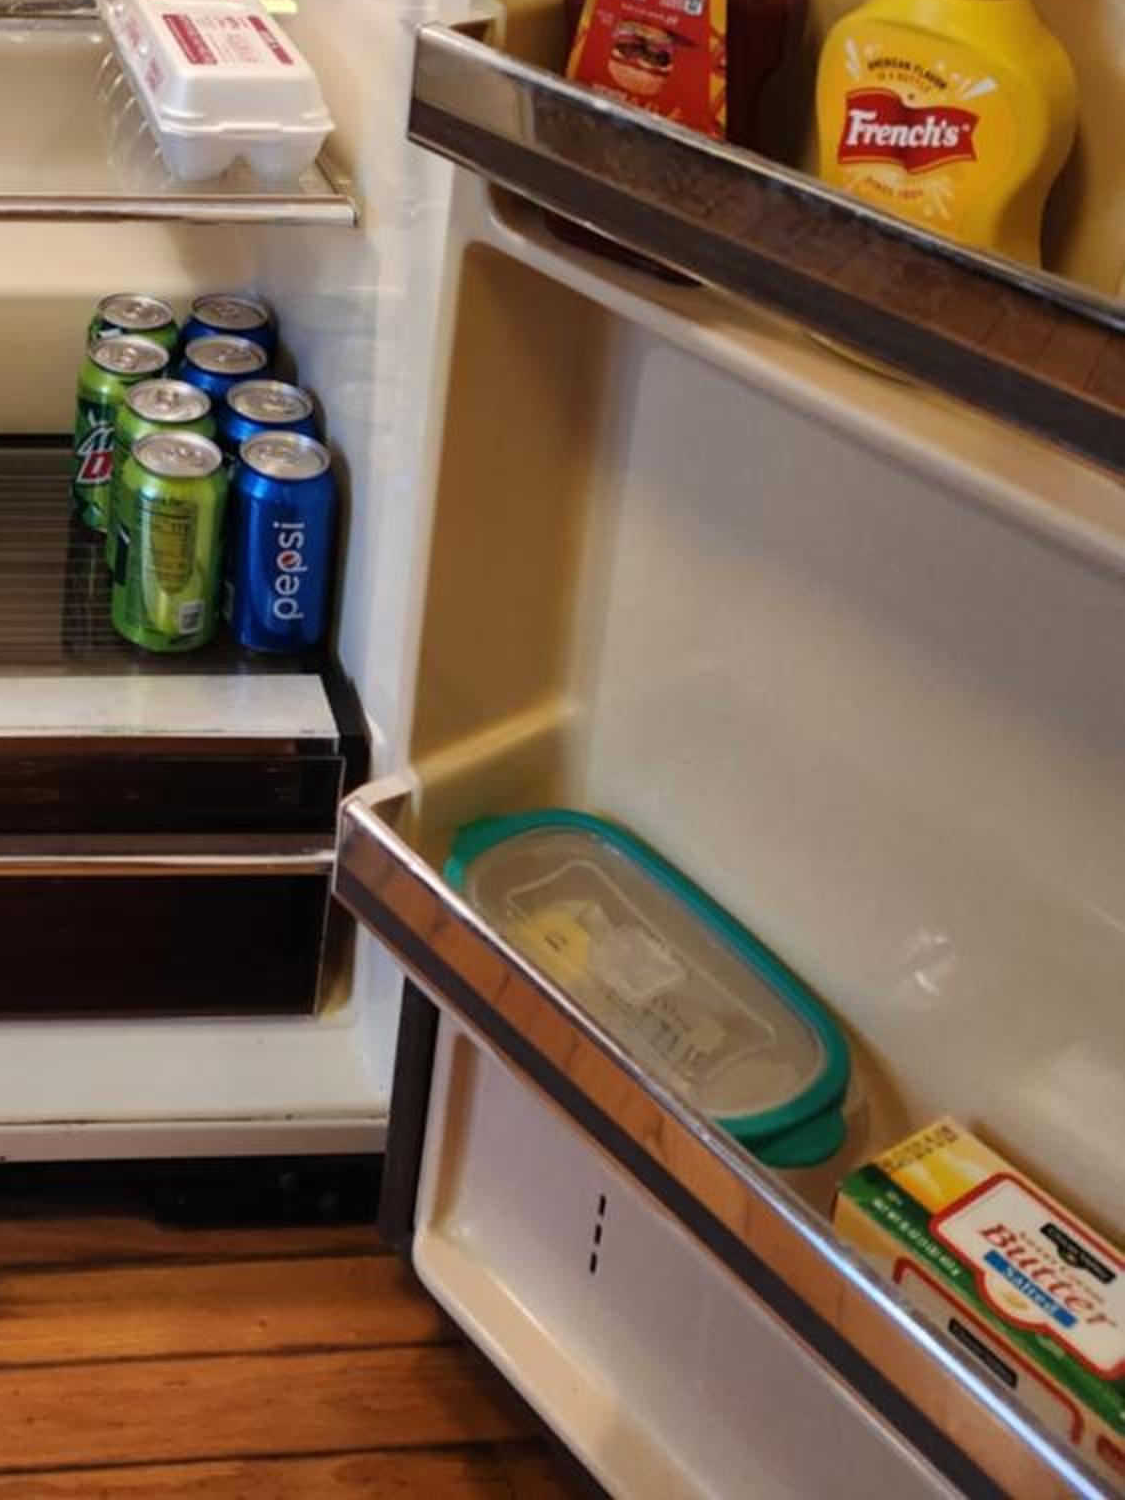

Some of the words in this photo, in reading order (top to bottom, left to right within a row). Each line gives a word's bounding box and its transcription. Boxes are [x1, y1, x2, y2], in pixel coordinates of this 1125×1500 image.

[846, 108, 960, 148] French's
[272, 521, 309, 621] pepsi
[979, 1223, 1117, 1327] Butter
